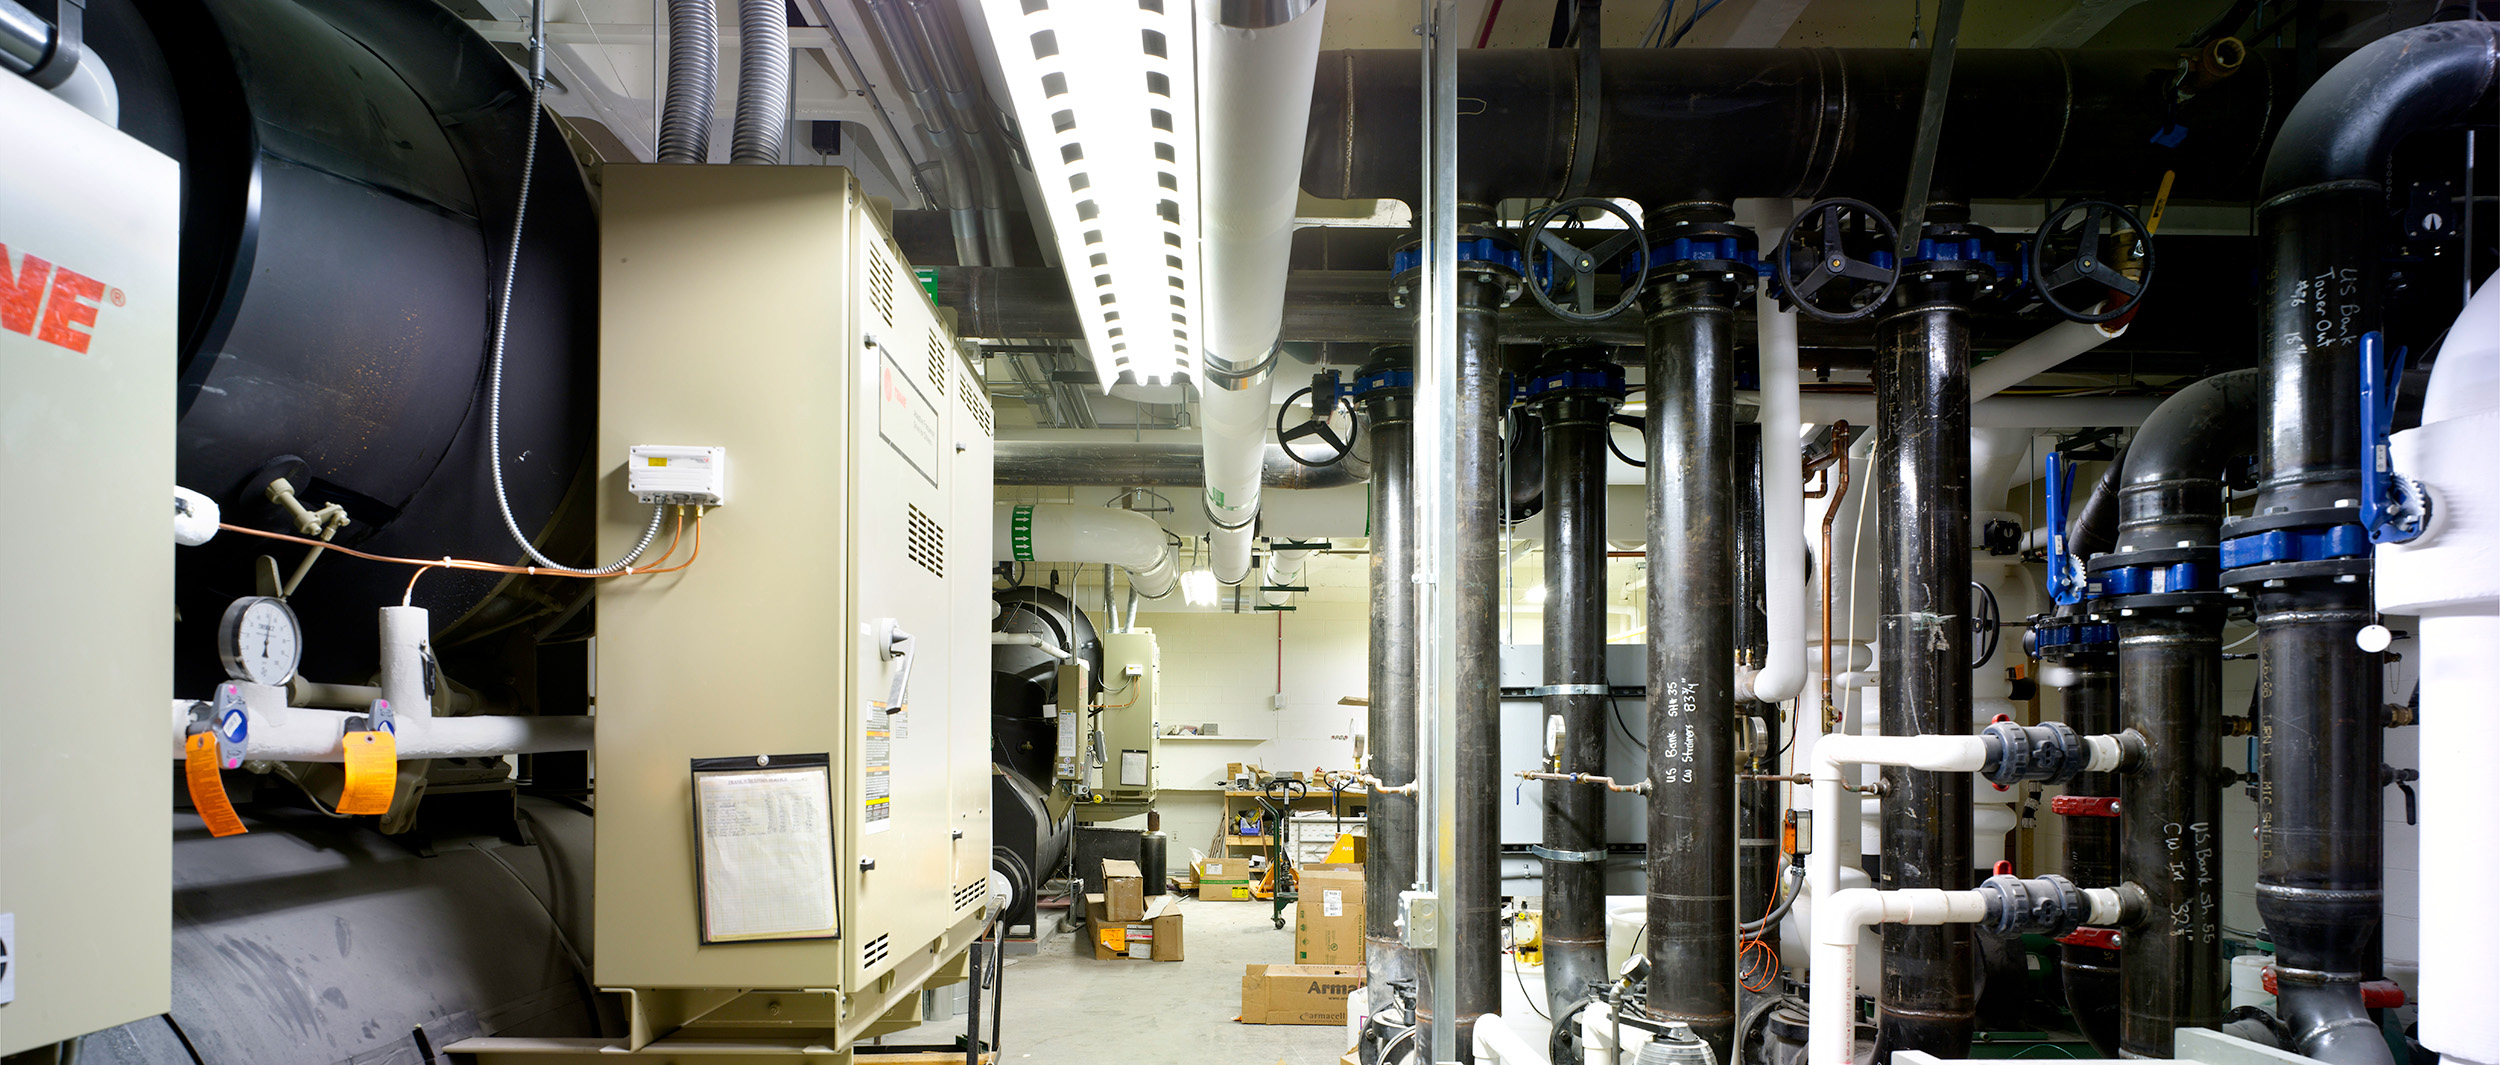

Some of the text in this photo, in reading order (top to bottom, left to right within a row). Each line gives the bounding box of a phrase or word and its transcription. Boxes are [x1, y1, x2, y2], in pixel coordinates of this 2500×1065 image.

[2314, 266, 2336, 347] Tower Out
[2340, 268, 2360, 346] US Bank
[1665, 730, 1678, 758] Bank
[1666, 768, 1677, 783] US
[2169, 861, 2185, 881] In
[2196, 848, 2213, 887] Bank
[2202, 923, 2215, 944] 55
[1309, 1012, 1345, 1020] armacell
